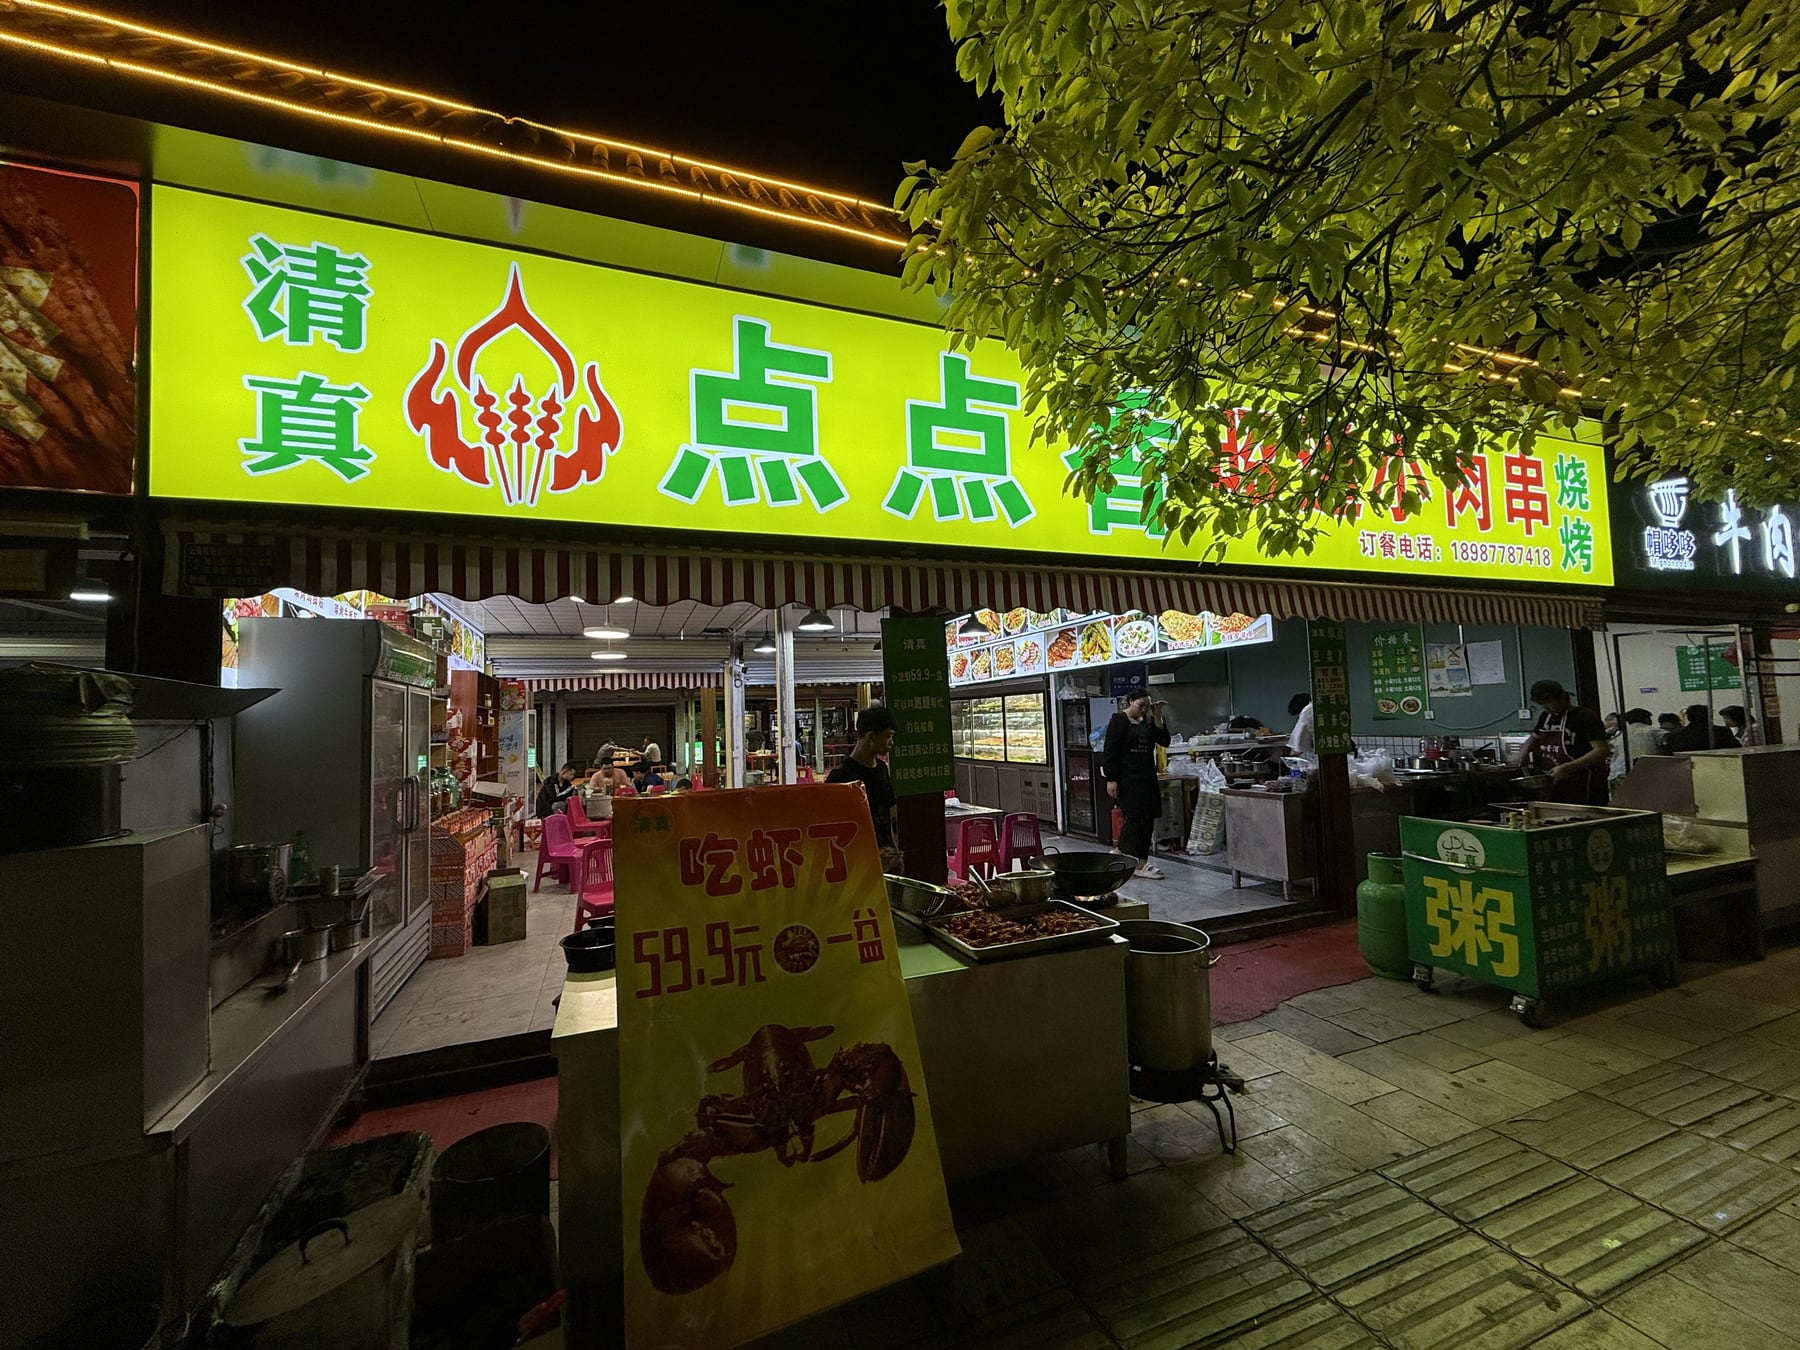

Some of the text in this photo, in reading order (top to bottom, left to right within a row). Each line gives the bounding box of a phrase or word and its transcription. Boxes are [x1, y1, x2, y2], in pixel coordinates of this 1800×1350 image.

[239, 231, 376, 484] 清真
[1450, 540, 1552, 568] 18987787418
[1553, 451, 1594, 574] 烧烤
[679, 820, 858, 897] 吃虾了
[633, 920, 766, 999] 59.9元
[1423, 875, 1520, 977] 粥
